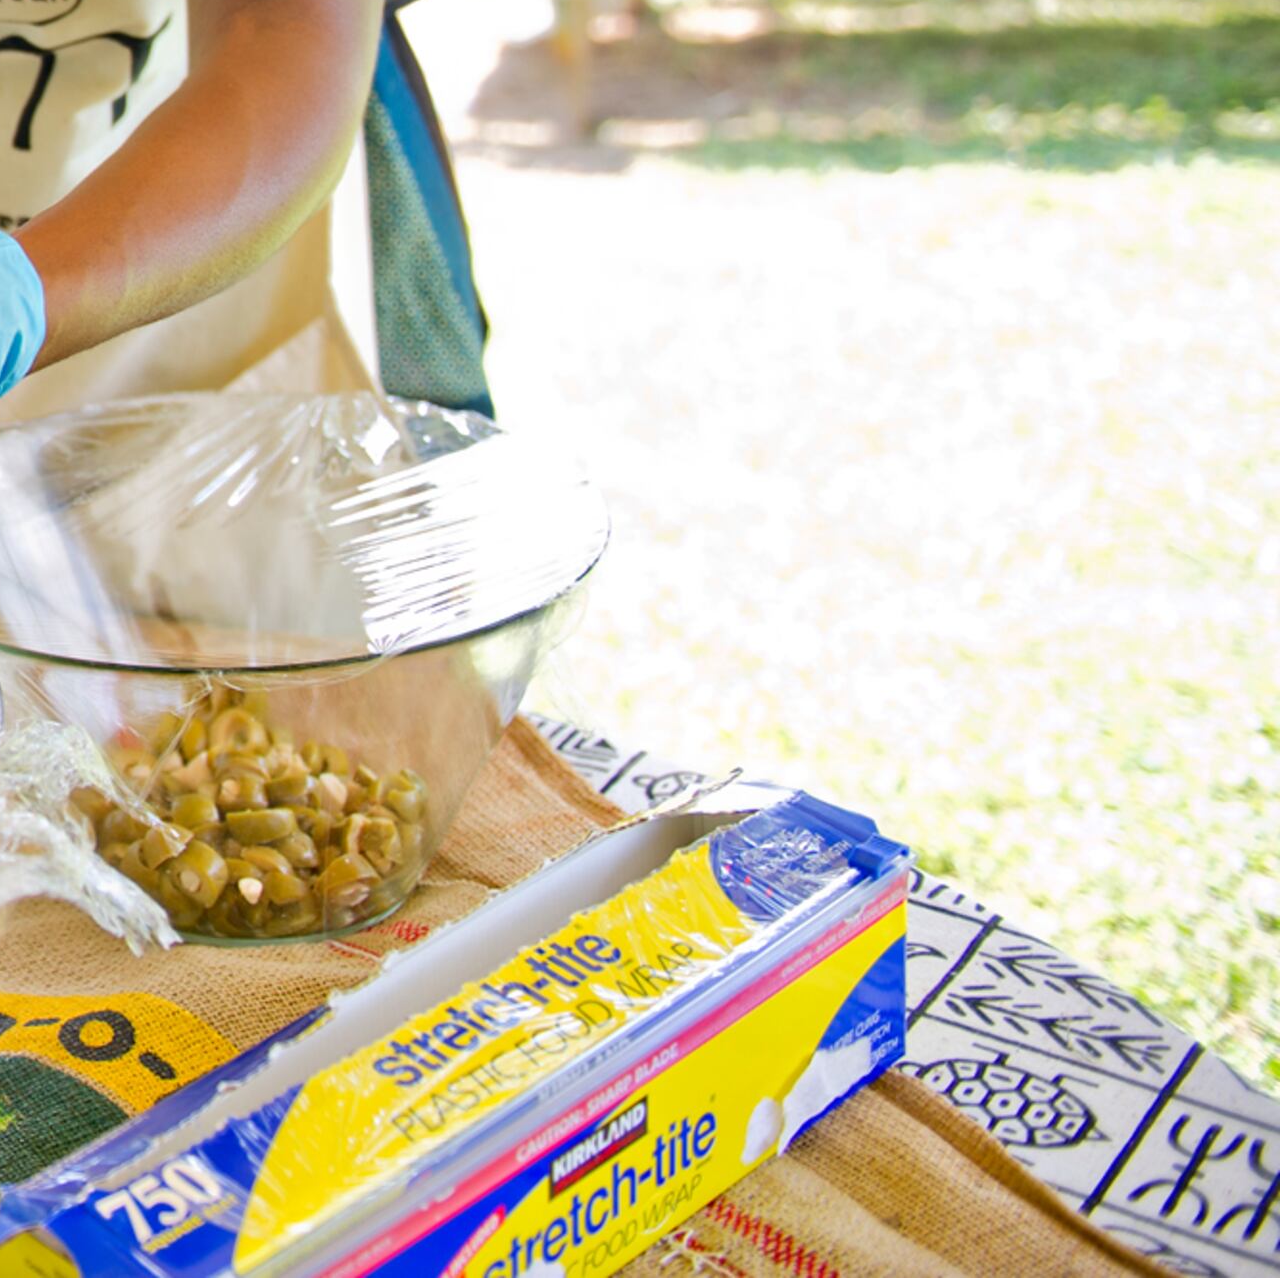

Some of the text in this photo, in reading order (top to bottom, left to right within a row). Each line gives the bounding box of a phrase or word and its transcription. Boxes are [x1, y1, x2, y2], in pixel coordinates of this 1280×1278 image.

[391, 1050, 532, 1142] PLASTIC
[615, 940, 695, 1009] WRAP
[633, 1041, 680, 1085] BLADE
[552, 1102, 647, 1184] KIRKLAND
[94, 1154, 222, 1246] 750
[642, 1173, 703, 1230] WRAP
